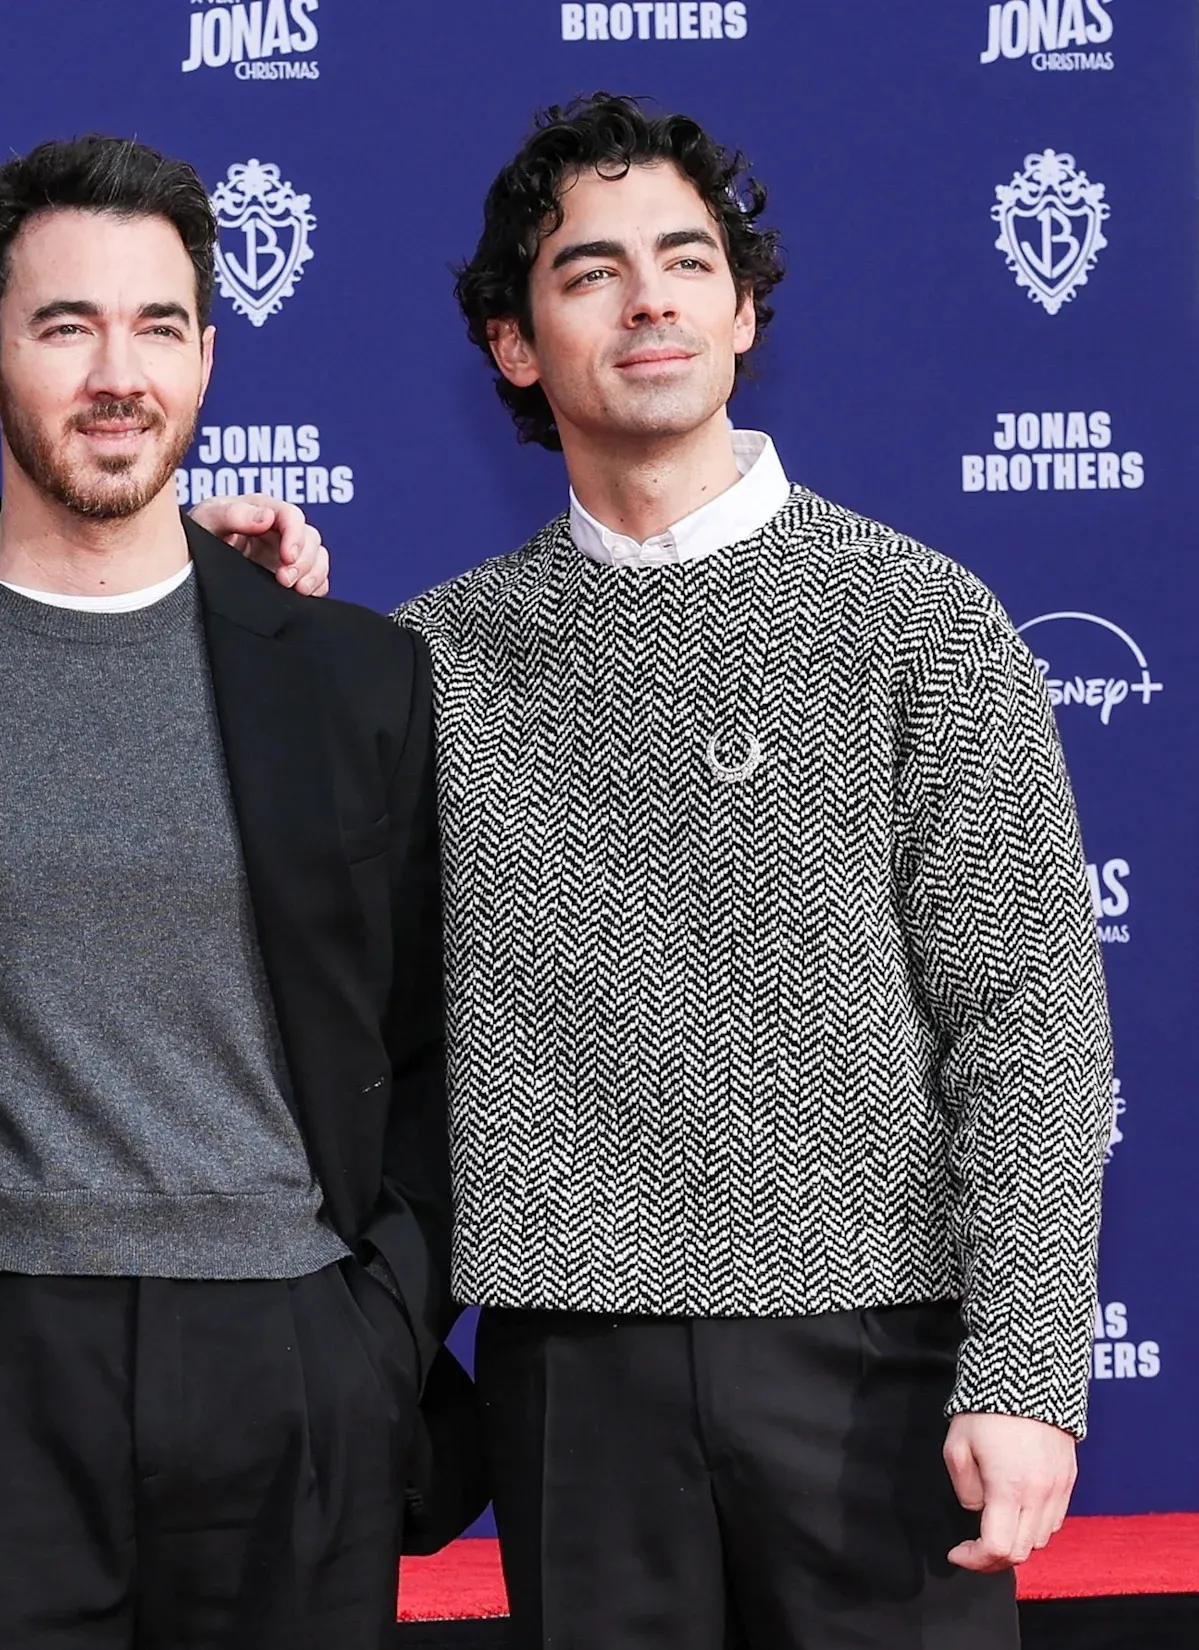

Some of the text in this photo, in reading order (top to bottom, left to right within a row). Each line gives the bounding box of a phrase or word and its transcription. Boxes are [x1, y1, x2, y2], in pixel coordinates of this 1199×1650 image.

[182, 0, 319, 72] JONAS
[561, 1, 747, 41] BROTHERS
[980, 0, 1113, 64] JONAS
[234, 61, 320, 80] CHRISTMAS
[1031, 52, 1114, 71] CHRISTMAS
[198, 424, 320, 464] JONAS
[994, 411, 1111, 450] JONAS
[174, 465, 355, 505] BROTHERS
[962, 451, 1144, 492] BROTHERS
